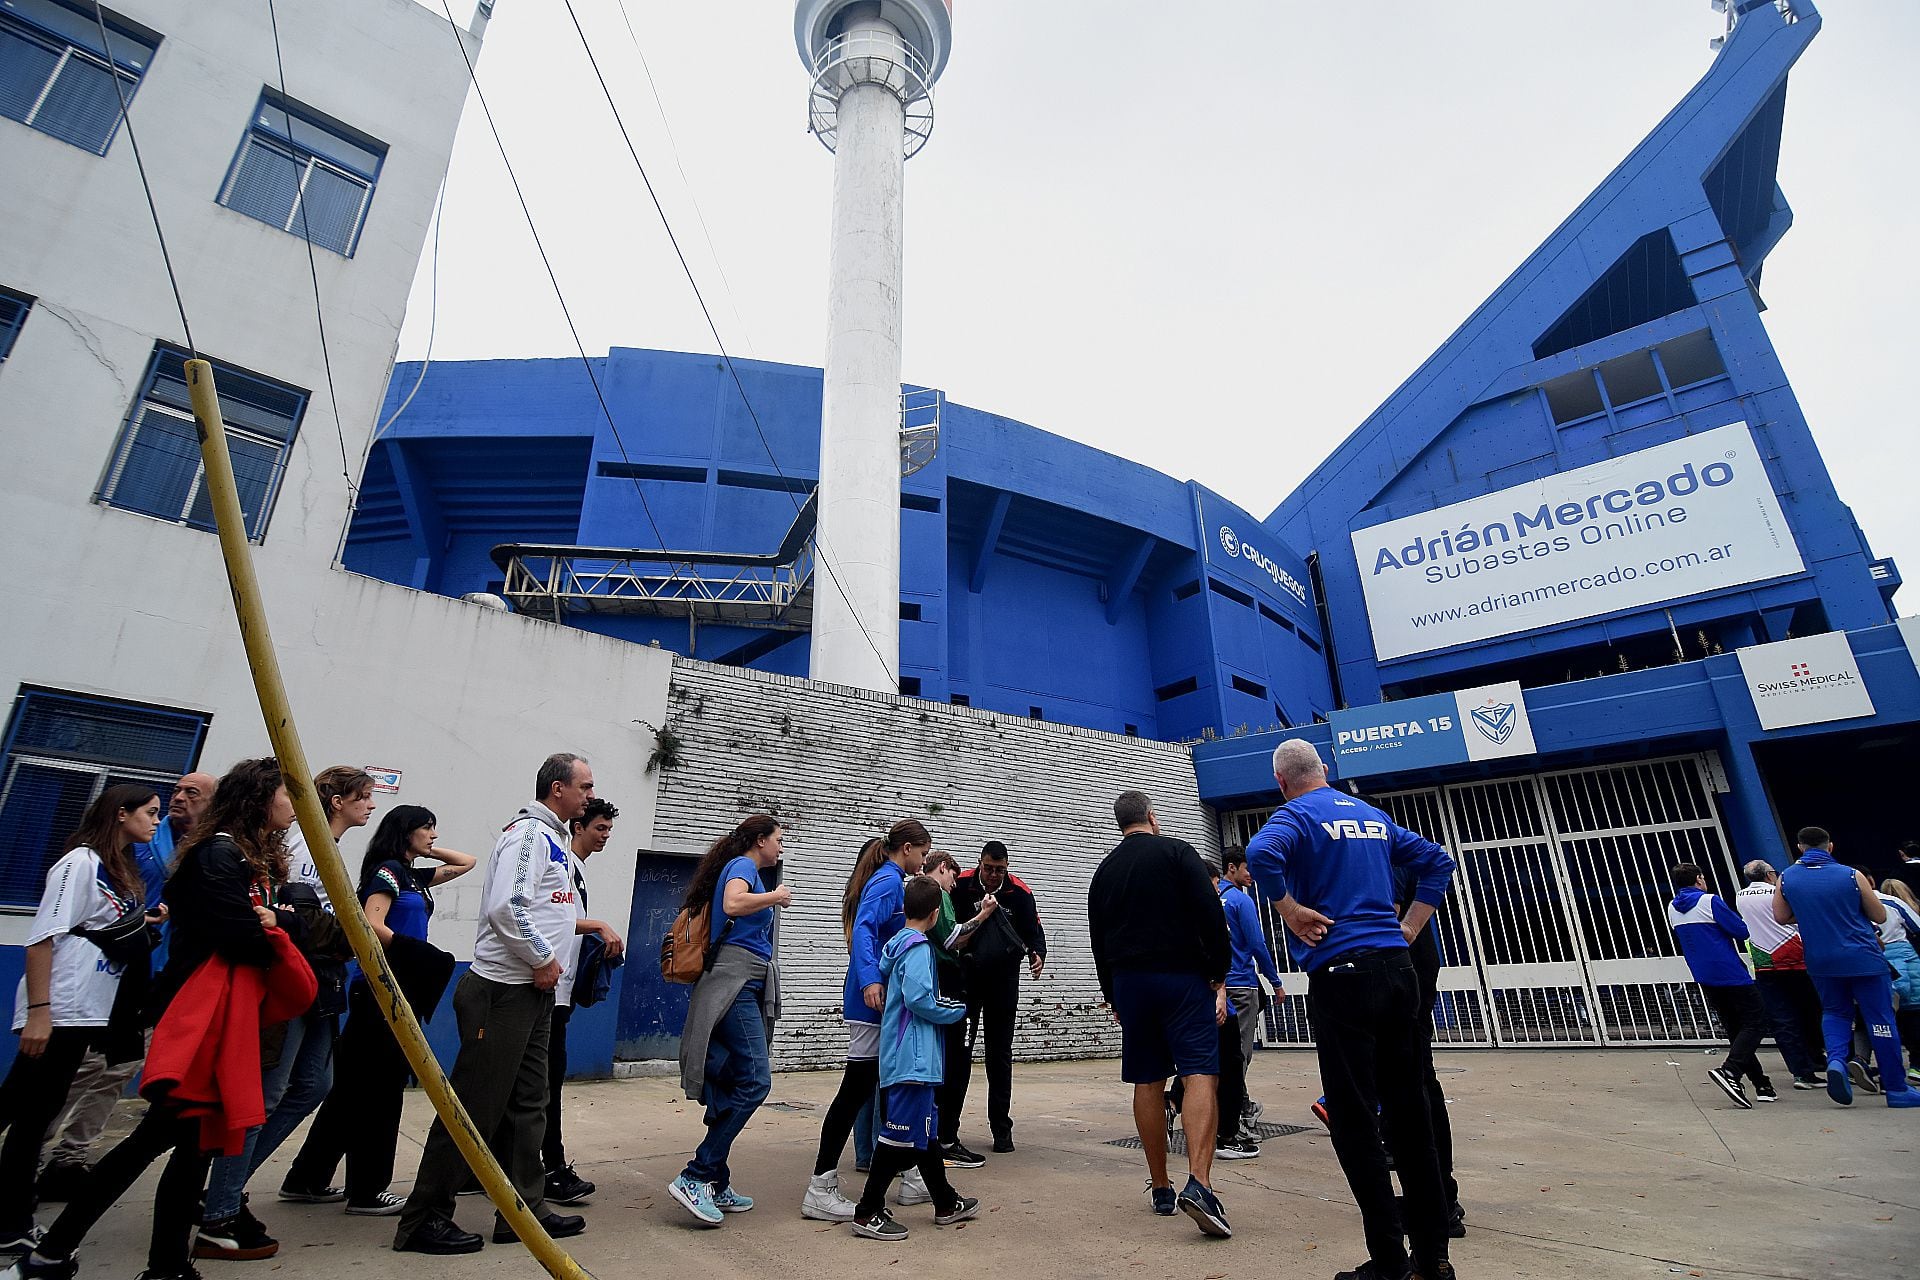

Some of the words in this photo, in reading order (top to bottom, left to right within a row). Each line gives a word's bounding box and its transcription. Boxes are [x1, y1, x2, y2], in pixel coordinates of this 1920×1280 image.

[1373, 523, 1510, 576] Adrián
[1512, 462, 1734, 538] Mercado
[1425, 536, 1571, 584] Subastas
[1580, 507, 1688, 545] Online
[1411, 543, 1733, 628] www.adrianmercado.com.ar
[1757, 680, 1798, 693] SWISS
[1800, 671, 1855, 687] MEDICAL
[1760, 688, 1806, 698] MEDICINA
[1810, 681, 1856, 691] PRIVADA
[1337, 721, 1425, 746] PUERTA
[1428, 716, 1453, 733] 15
[1340, 746, 1368, 755] ACCESO
[1375, 741, 1403, 750] ACCESS
